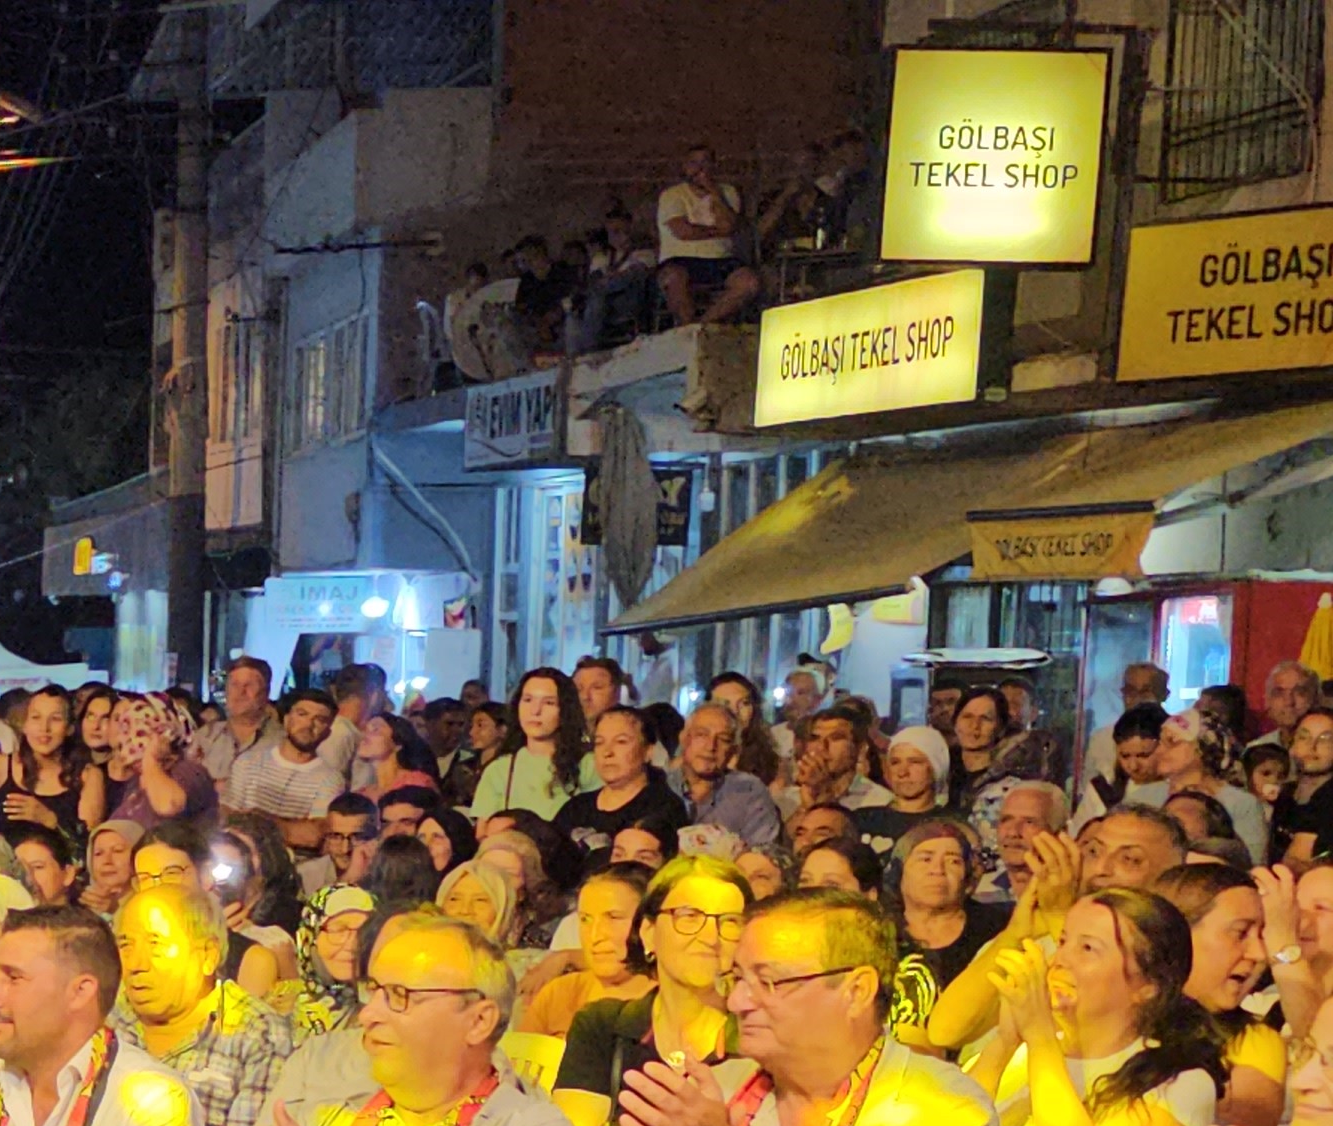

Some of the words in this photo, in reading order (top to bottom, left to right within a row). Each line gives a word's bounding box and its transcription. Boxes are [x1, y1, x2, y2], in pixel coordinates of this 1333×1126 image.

[938, 118, 1056, 159] GÖLBAŞI
[910, 161, 995, 188] TEKEL
[1004, 162, 1079, 189] SHOP
[1166, 304, 1263, 344] TEKEL
[780, 332, 846, 386] GÖLBAŞI
[850, 325, 901, 372] TEKEL
[905, 315, 955, 363] SHOP
